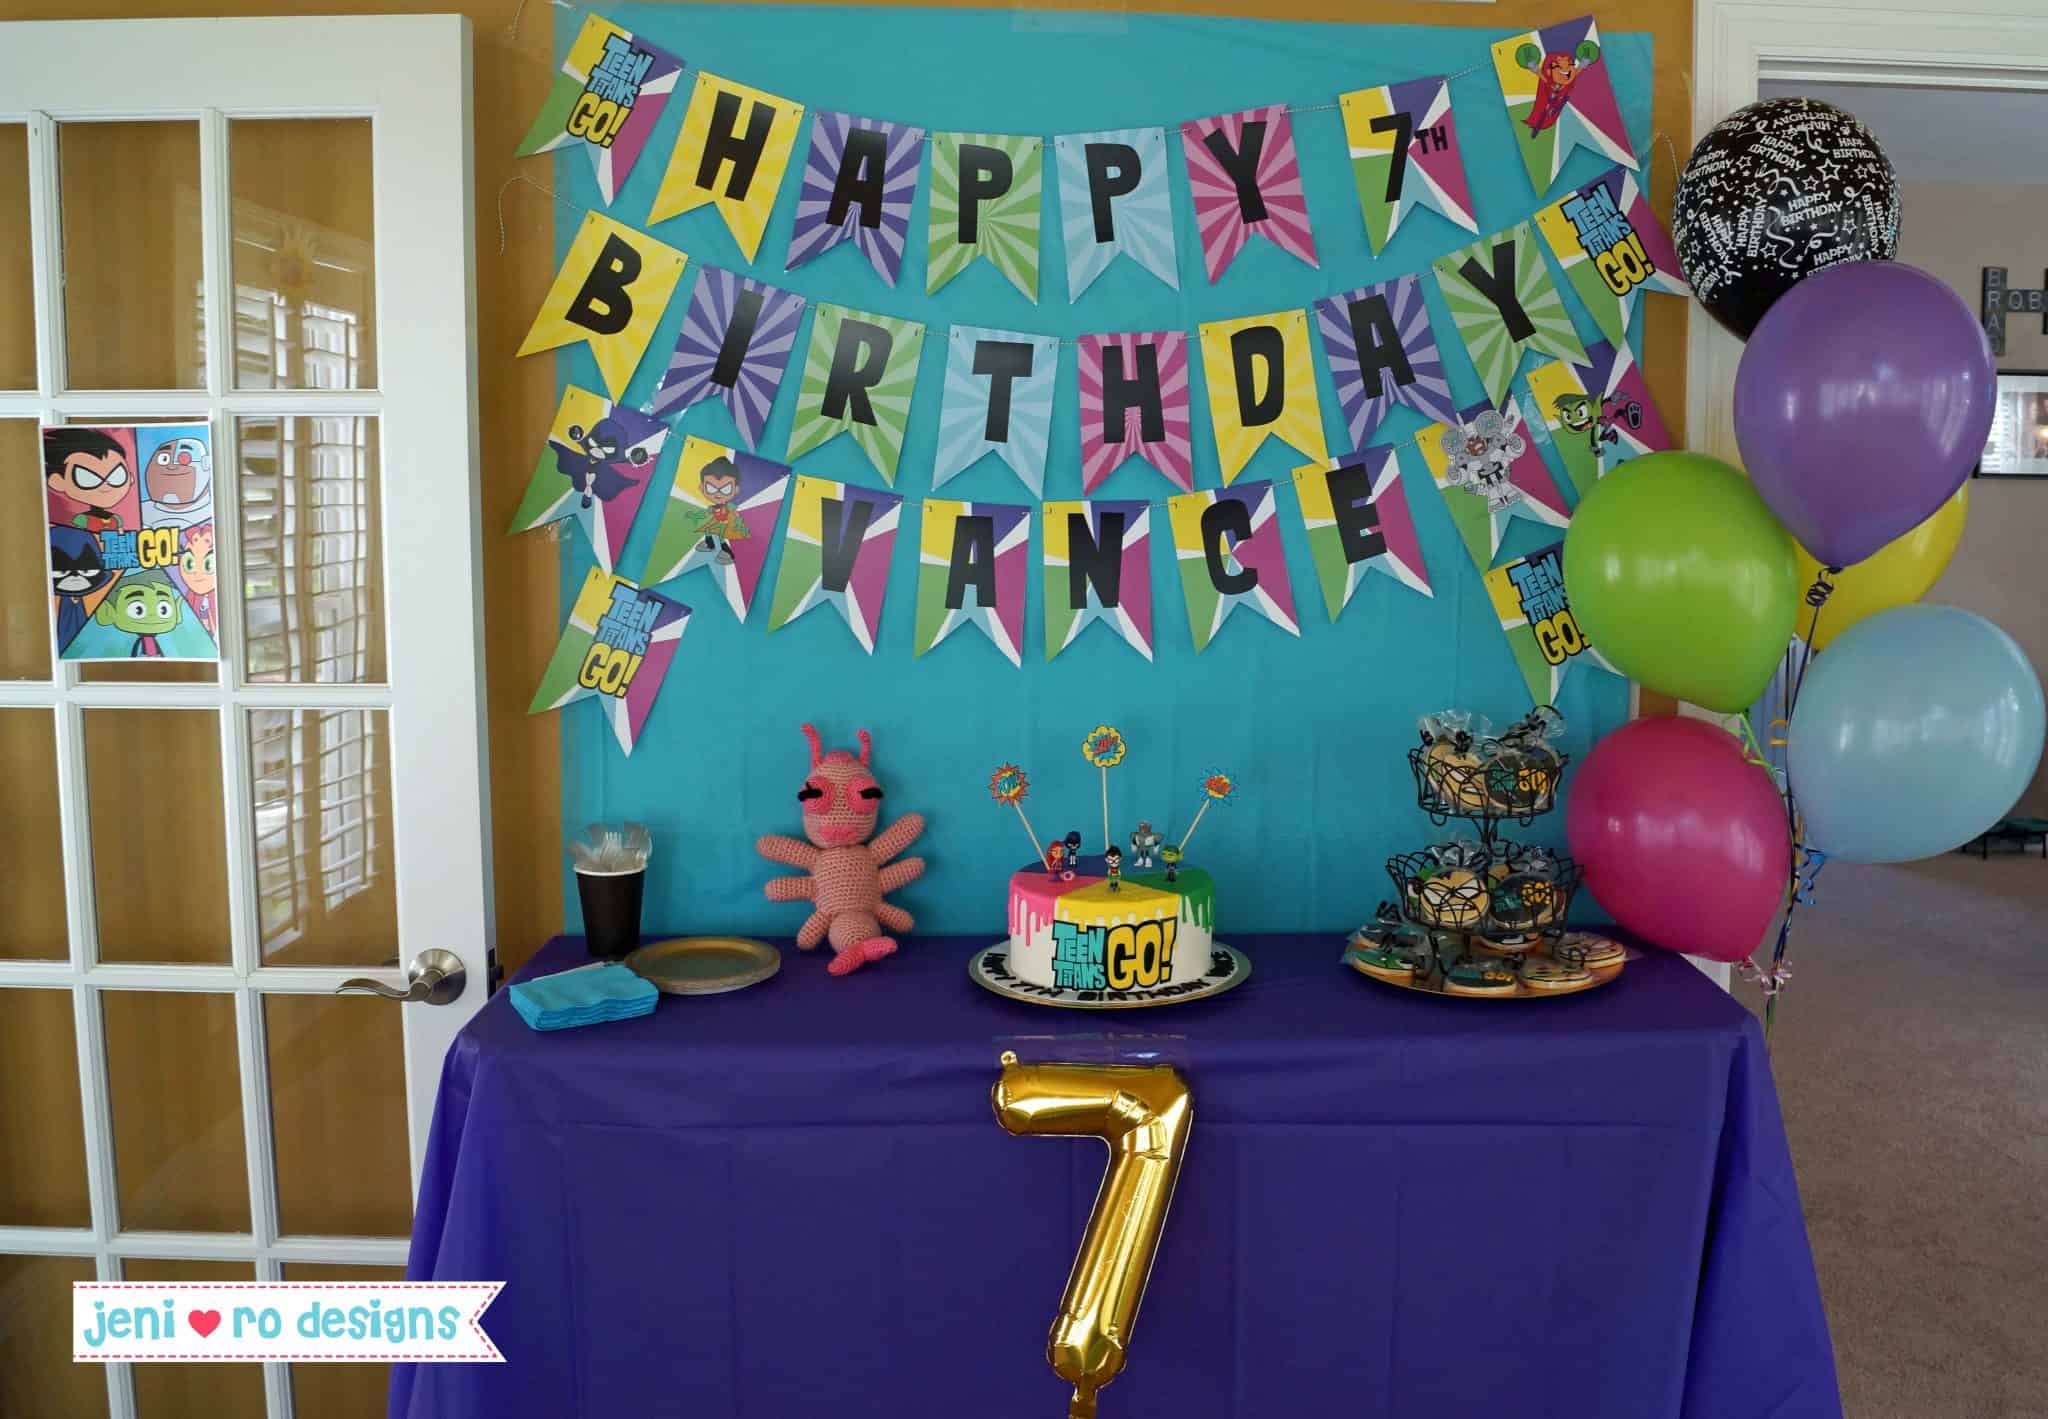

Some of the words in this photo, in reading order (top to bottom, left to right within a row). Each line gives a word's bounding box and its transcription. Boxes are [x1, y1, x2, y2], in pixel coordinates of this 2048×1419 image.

[602, 33, 655, 84] TEEN
[585, 67, 640, 109] TITANS
[566, 93, 633, 148] GO!
[695, 90, 1268, 244] HAPPY
[1369, 112, 1448, 203] 7TH
[1749, 144, 1806, 172] BIRTHDAY
[1760, 135, 1804, 157] HAPPY
[1833, 149, 1877, 159] BIRTHDA
[1560, 181, 1620, 233] TEEN
[1780, 200, 1843, 226] BIRTHDAY
[1788, 190, 1831, 212] HAPPY
[1577, 211, 1633, 258] TITANS
[1699, 211, 1733, 264] BIRTHDAY
[1735, 205, 1752, 247] HAPPY
[1746, 195, 1768, 257] BIRTHDAY
[1594, 232, 1656, 297] GO!
[1813, 242, 1853, 266] HAPPY
[565, 232, 1536, 443] BIRTHDAY
[100, 530, 138, 554] TEEN
[137, 527, 179, 569] GO!
[821, 463, 1387, 610] VANCE
[1507, 552, 1563, 600] TEEN
[610, 580, 664, 629] TEEN
[1519, 588, 1568, 625] TITAN
[594, 615, 653, 656] TITANS
[578, 643, 643, 698] GO!
[1053, 920, 1107, 963] TEEN
[1105, 917, 1177, 990] GO!
[1052, 959, 1107, 990] TITANS
